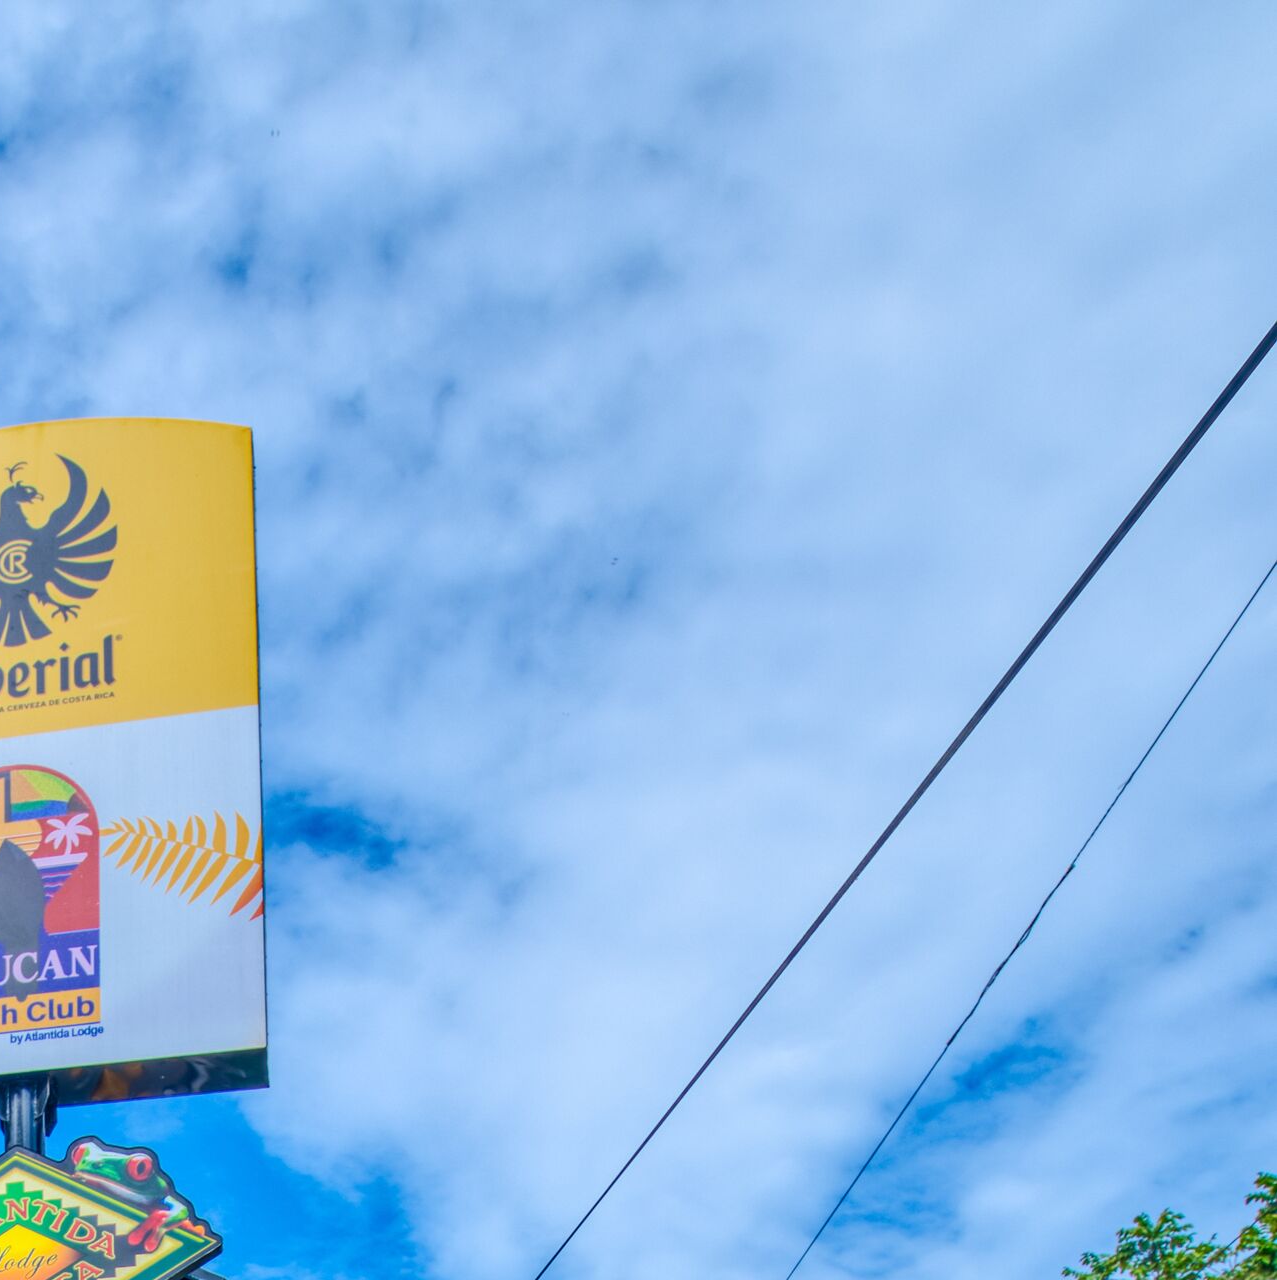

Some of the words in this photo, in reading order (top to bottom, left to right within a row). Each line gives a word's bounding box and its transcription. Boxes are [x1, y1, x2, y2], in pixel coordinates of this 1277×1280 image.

[7, 702, 47, 712] CERVEZA
[49, 698, 60, 706] DE
[62, 695, 92, 704] COSTA
[94, 691, 115, 700] RICA
[27, 996, 95, 1022] Club
[10, 1034, 24, 1044] by
[24, 1029, 70, 1042] Atlantida
[72, 1025, 104, 1038] Lodge
